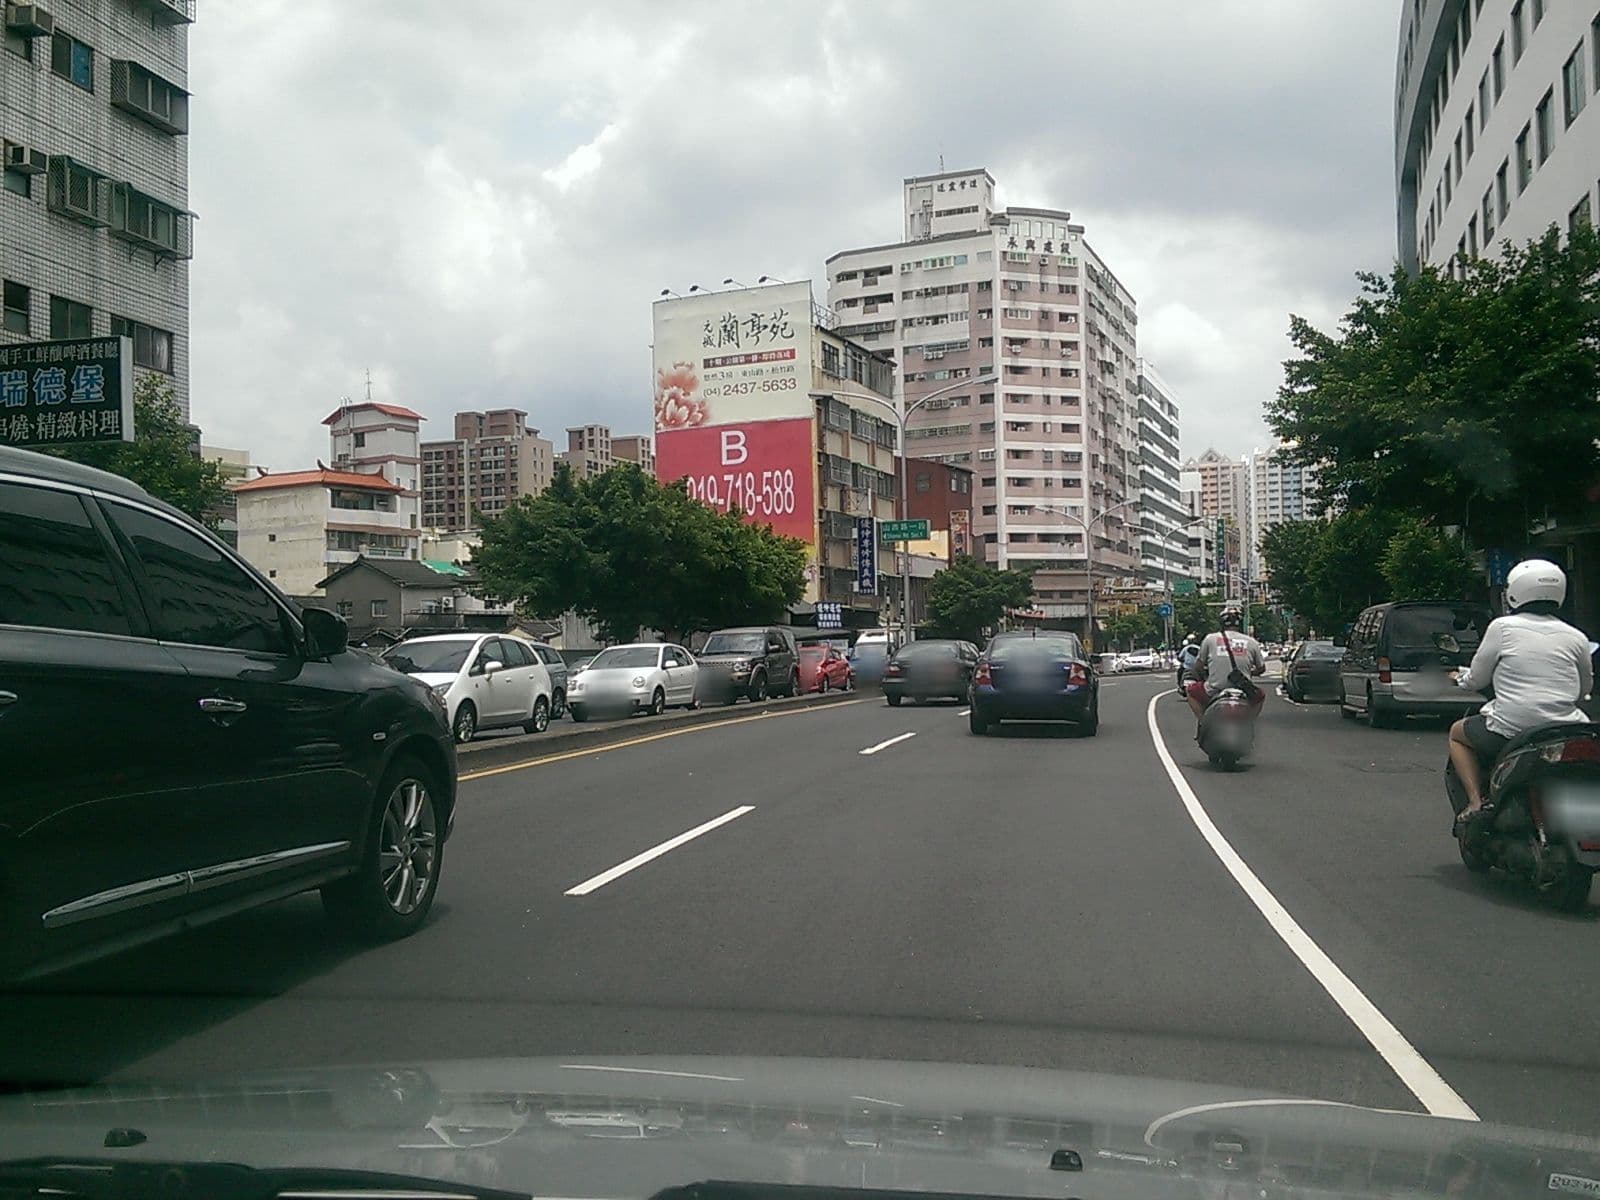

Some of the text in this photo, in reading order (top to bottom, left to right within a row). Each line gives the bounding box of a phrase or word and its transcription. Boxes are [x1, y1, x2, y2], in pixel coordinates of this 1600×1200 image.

[0, 364, 105, 408] 瑞德堡
[723, 378, 797, 396] 2437-5633
[721, 430, 748, 466] B
